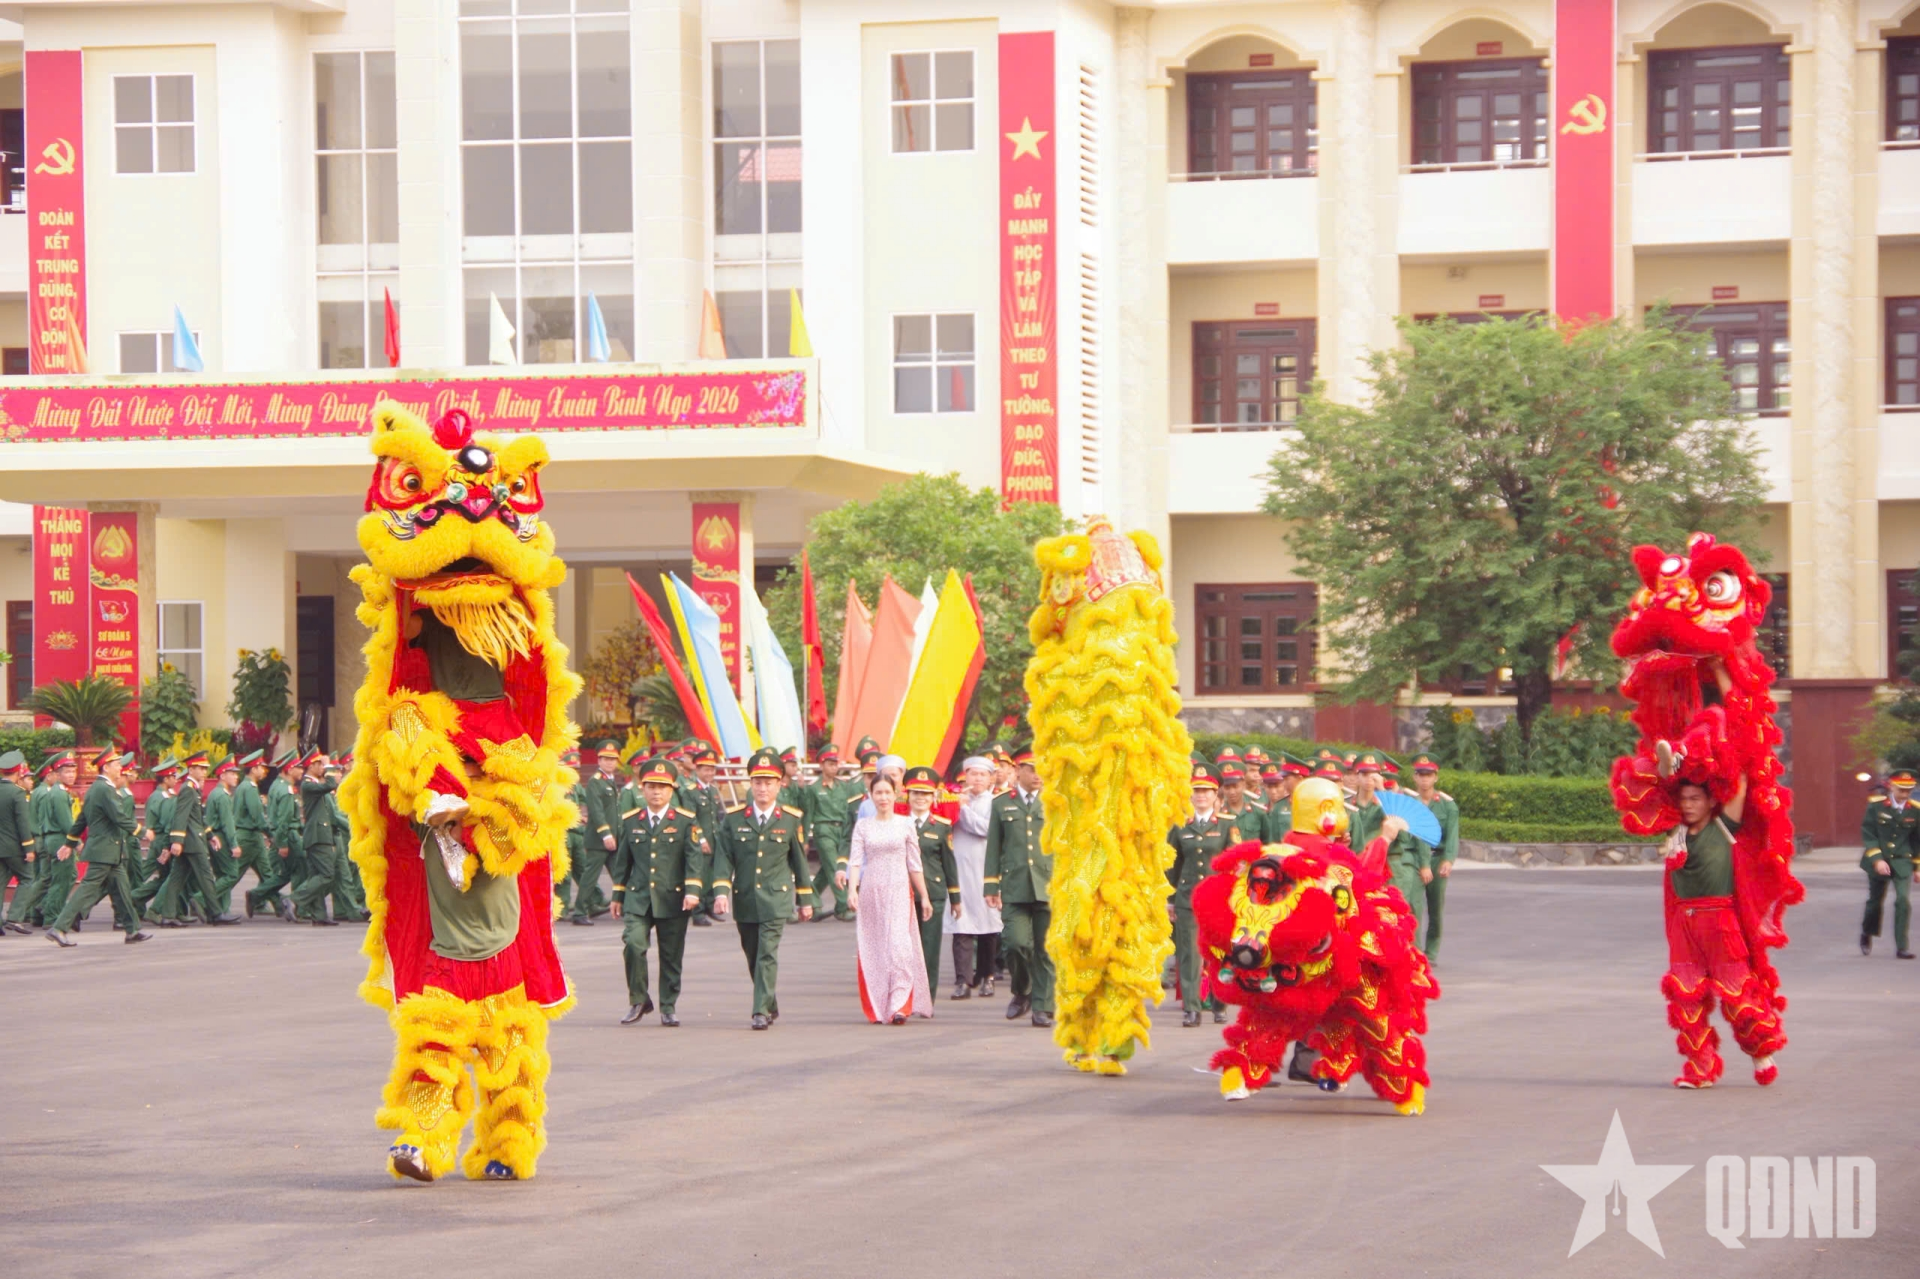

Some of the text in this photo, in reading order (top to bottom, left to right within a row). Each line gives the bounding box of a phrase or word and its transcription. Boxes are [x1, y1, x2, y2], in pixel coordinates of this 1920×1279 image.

[39, 208, 74, 226] ĐOÀN
[1008, 218, 1048, 239] MẠNH
[44, 230, 70, 250] KẾT
[1013, 244, 1043, 264] HỌC
[36, 259, 79, 273] TRUNG
[1014, 267, 1042, 290] TẬP
[38, 279, 77, 299] DŨNG,
[1018, 292, 1038, 312] VÀ
[50, 306, 67, 320] CƠ
[41, 329, 67, 348] ĐỘN
[44, 354, 66, 368] LIN
[1010, 347, 1047, 364] THEO
[1019, 371, 1039, 389] TƯ
[29, 396, 81, 435] Mừng
[87, 395, 123, 428] Đất
[127, 395, 174, 427] Nước
[216, 394, 257, 430] Mới,
[261, 392, 313, 431] Mừng
[319, 391, 369, 429] Đảng
[490, 387, 542, 425] Mừng
[547, 385, 598, 418] Xuân
[603, 384, 647, 417] Bính
[696, 385, 740, 414] 2026
[1014, 424, 1044, 444] ĐẠO
[1013, 447, 1045, 468] ĐỨC,
[1006, 475, 1054, 491] PHONG
[40, 513, 83, 534] THẮNG
[50, 543, 73, 561] MỌI
[53, 562, 70, 581] KẺ
